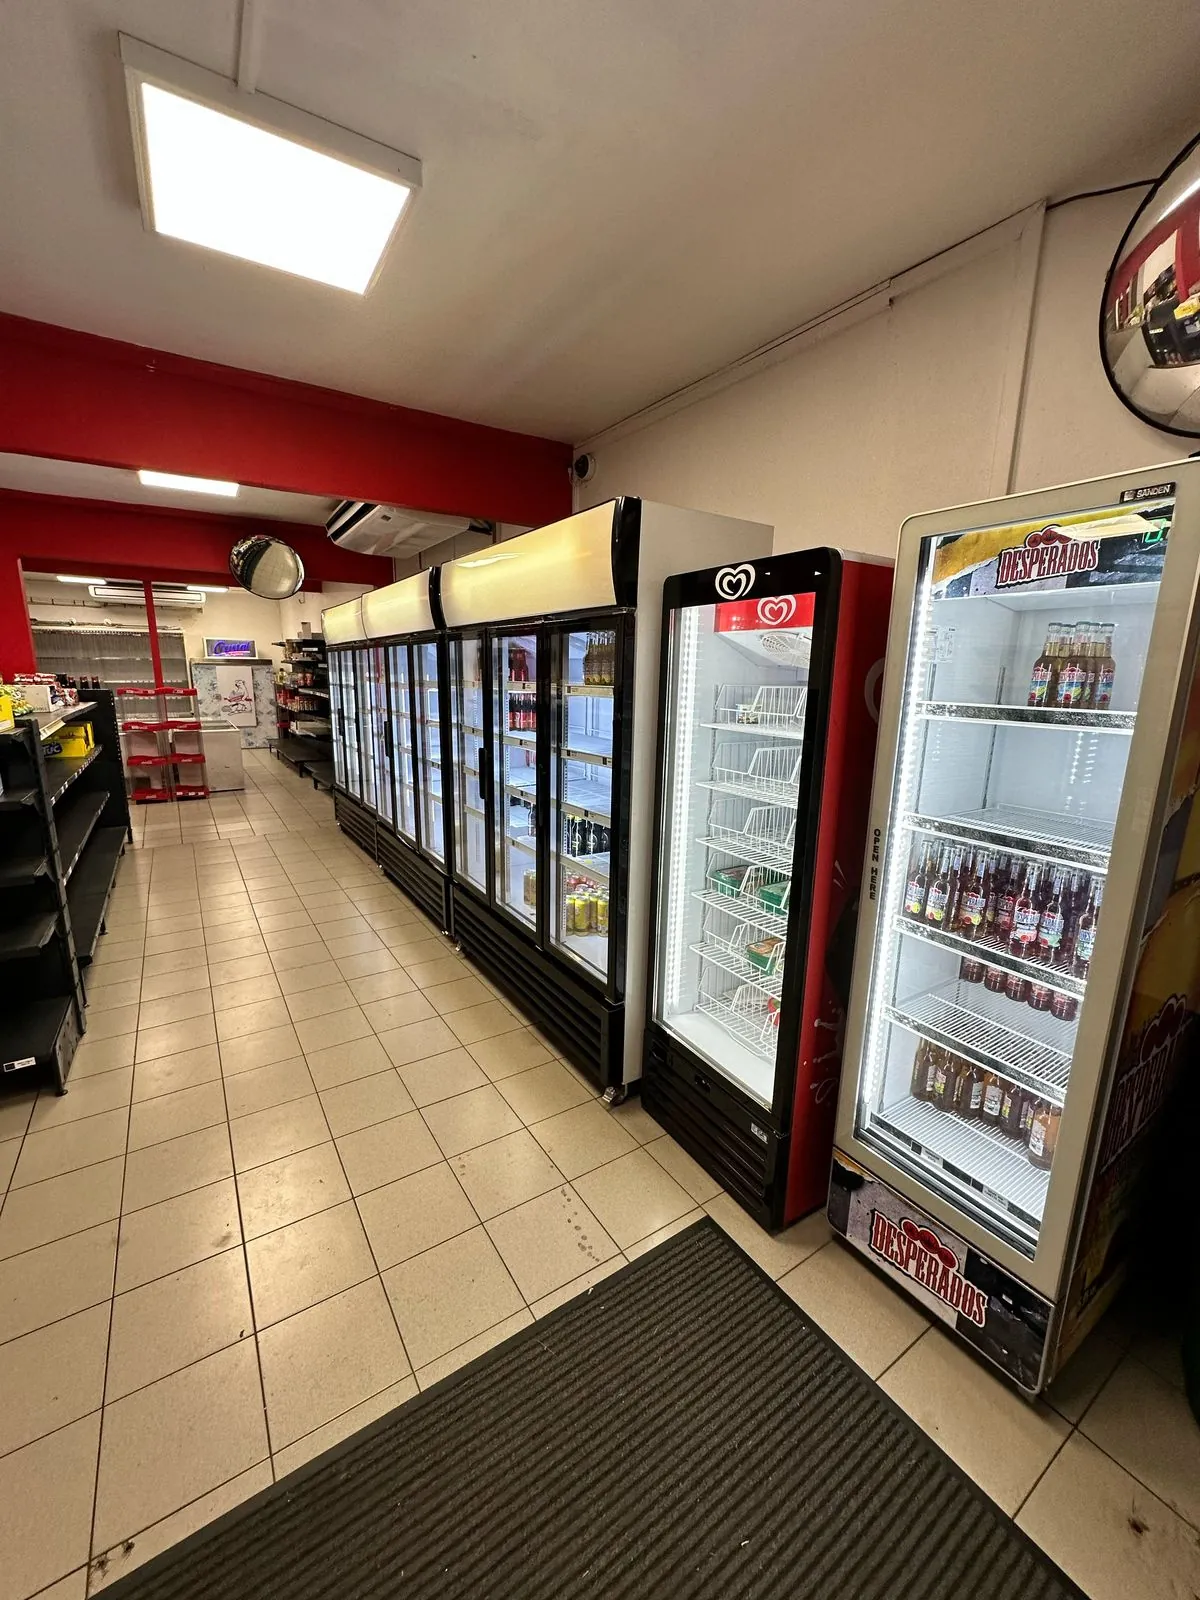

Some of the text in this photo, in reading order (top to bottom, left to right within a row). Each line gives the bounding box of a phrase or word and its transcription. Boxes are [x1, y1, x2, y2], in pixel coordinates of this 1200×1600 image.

[1136, 484, 1171, 498] SANDEN
[998, 538, 1099, 586] DESPERADOS
[869, 828, 881, 901] OPEN HERE
[871, 1211, 988, 1327] DESPERADOS
